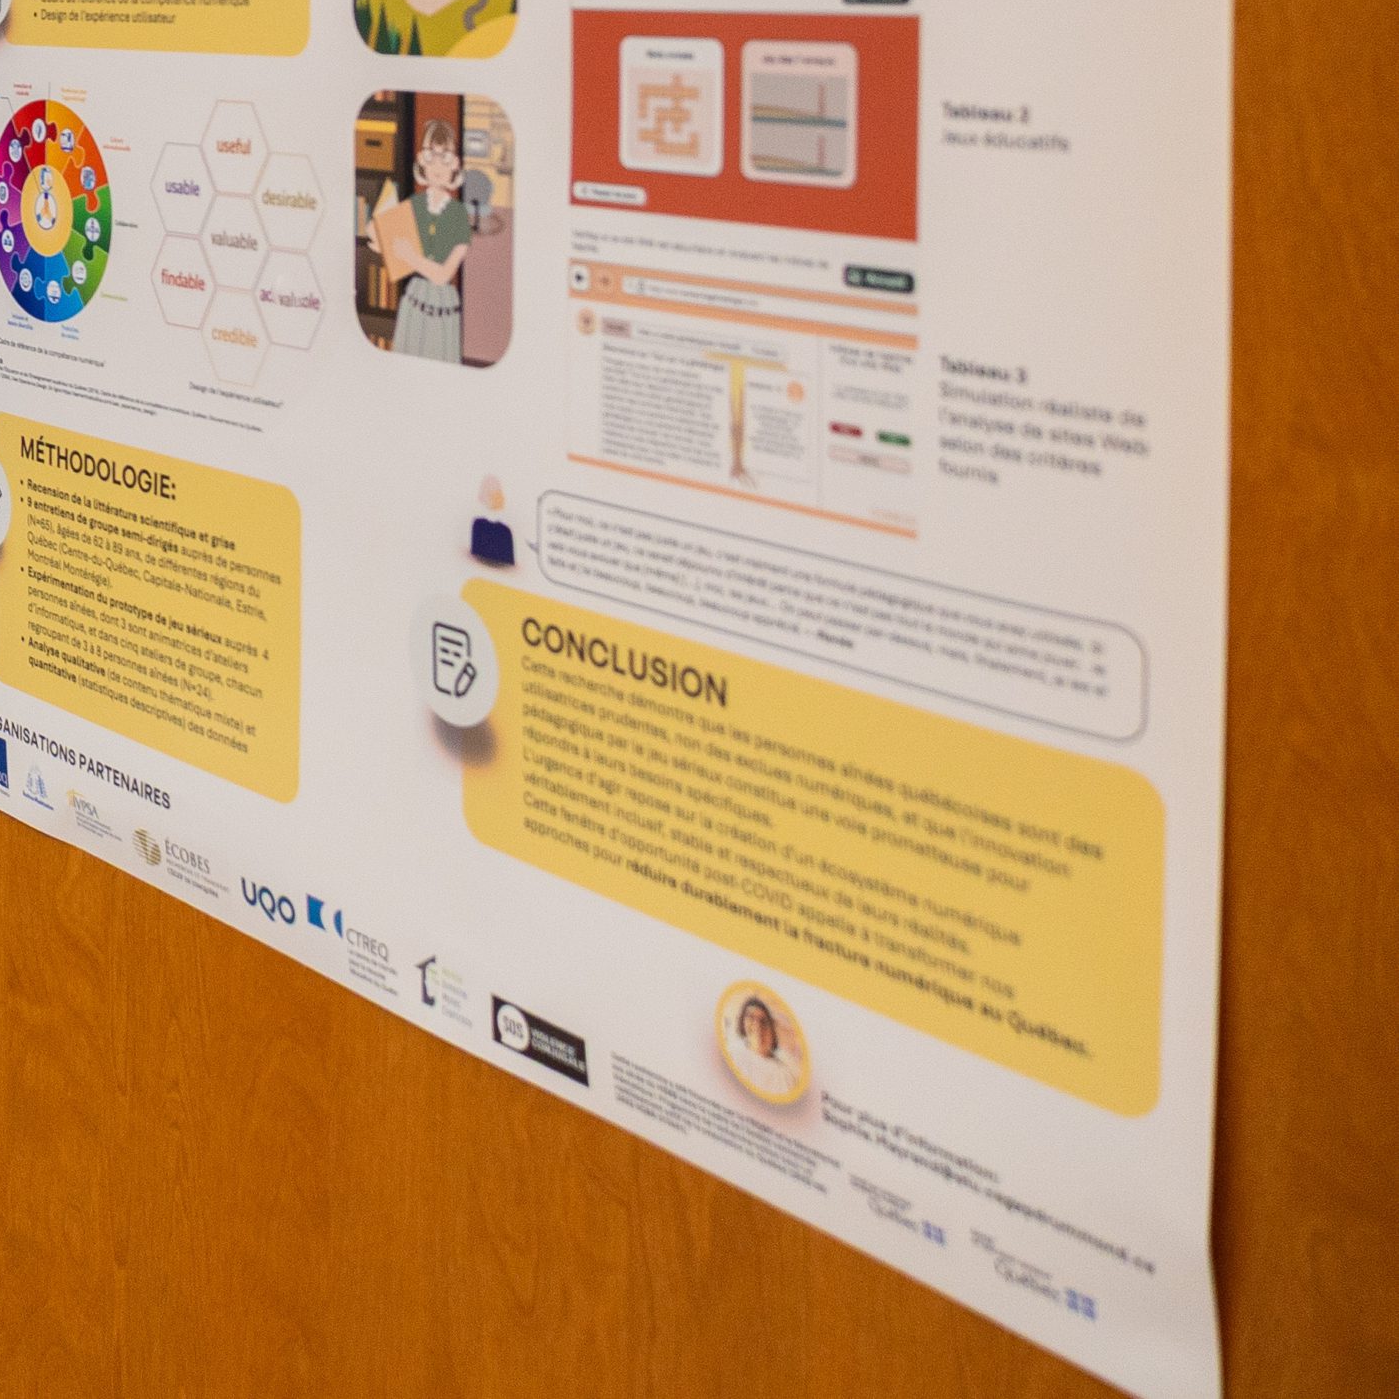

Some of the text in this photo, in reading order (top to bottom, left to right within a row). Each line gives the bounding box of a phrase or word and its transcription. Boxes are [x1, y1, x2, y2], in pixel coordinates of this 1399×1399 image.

[216, 137, 252, 156] useful
[165, 179, 201, 198] usable
[262, 189, 317, 210] desirable
[211, 230, 257, 252] valuable
[161, 267, 205, 291] findable
[211, 325, 257, 348] credible
[20, 436, 175, 499] MÉTHODOLOGIE:
[26, 478, 235, 551] Recension de la littérature scientifique et grise
[26, 495, 281, 584] 9 entretiens de groupe semi-dirigés auprès de personnes
[522, 618, 726, 706] CONCLUSION
[78, 753, 170, 809] PARTENAIRES
[165, 838, 210, 876] ÉCOBES
[240, 876, 296, 925] UQO
[346, 928, 389, 961] CTREQ
